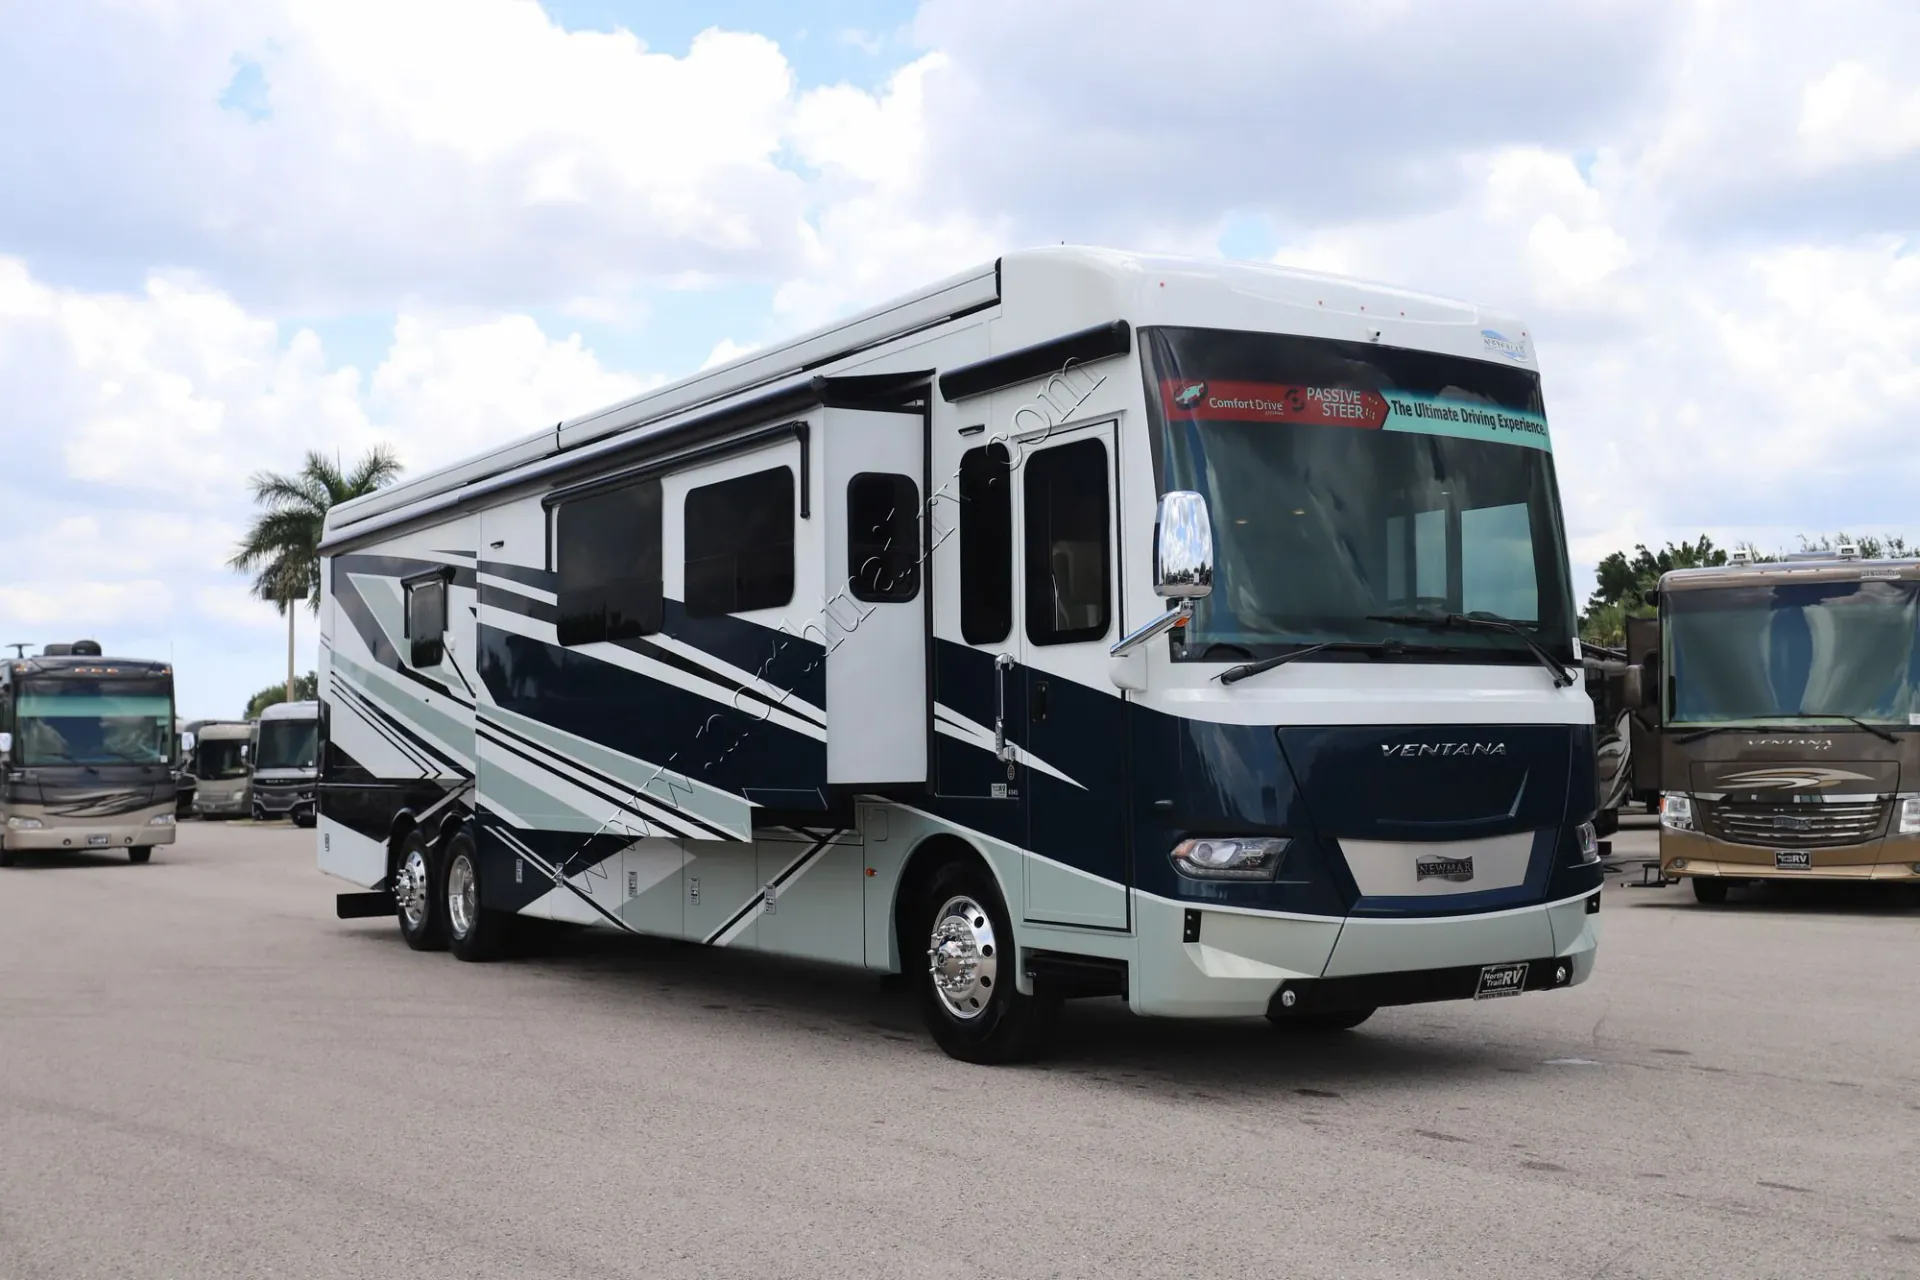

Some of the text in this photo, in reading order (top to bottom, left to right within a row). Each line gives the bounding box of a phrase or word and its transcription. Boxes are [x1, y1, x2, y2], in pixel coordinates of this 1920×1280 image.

[1209, 397, 1284, 411] Comfort Drive
[1306, 387, 1362, 405] PASSIVE
[1322, 402, 1364, 419] STEER
[1391, 400, 1413, 417] The
[1414, 403, 1459, 422] Ultimate
[1460, 408, 1496, 430] Driving
[1498, 414, 1547, 436] Experience.
[1381, 742, 1507, 757] VENTANA
[1420, 861, 1472, 876] NEWMAR
[1502, 969, 1523, 986] RV
